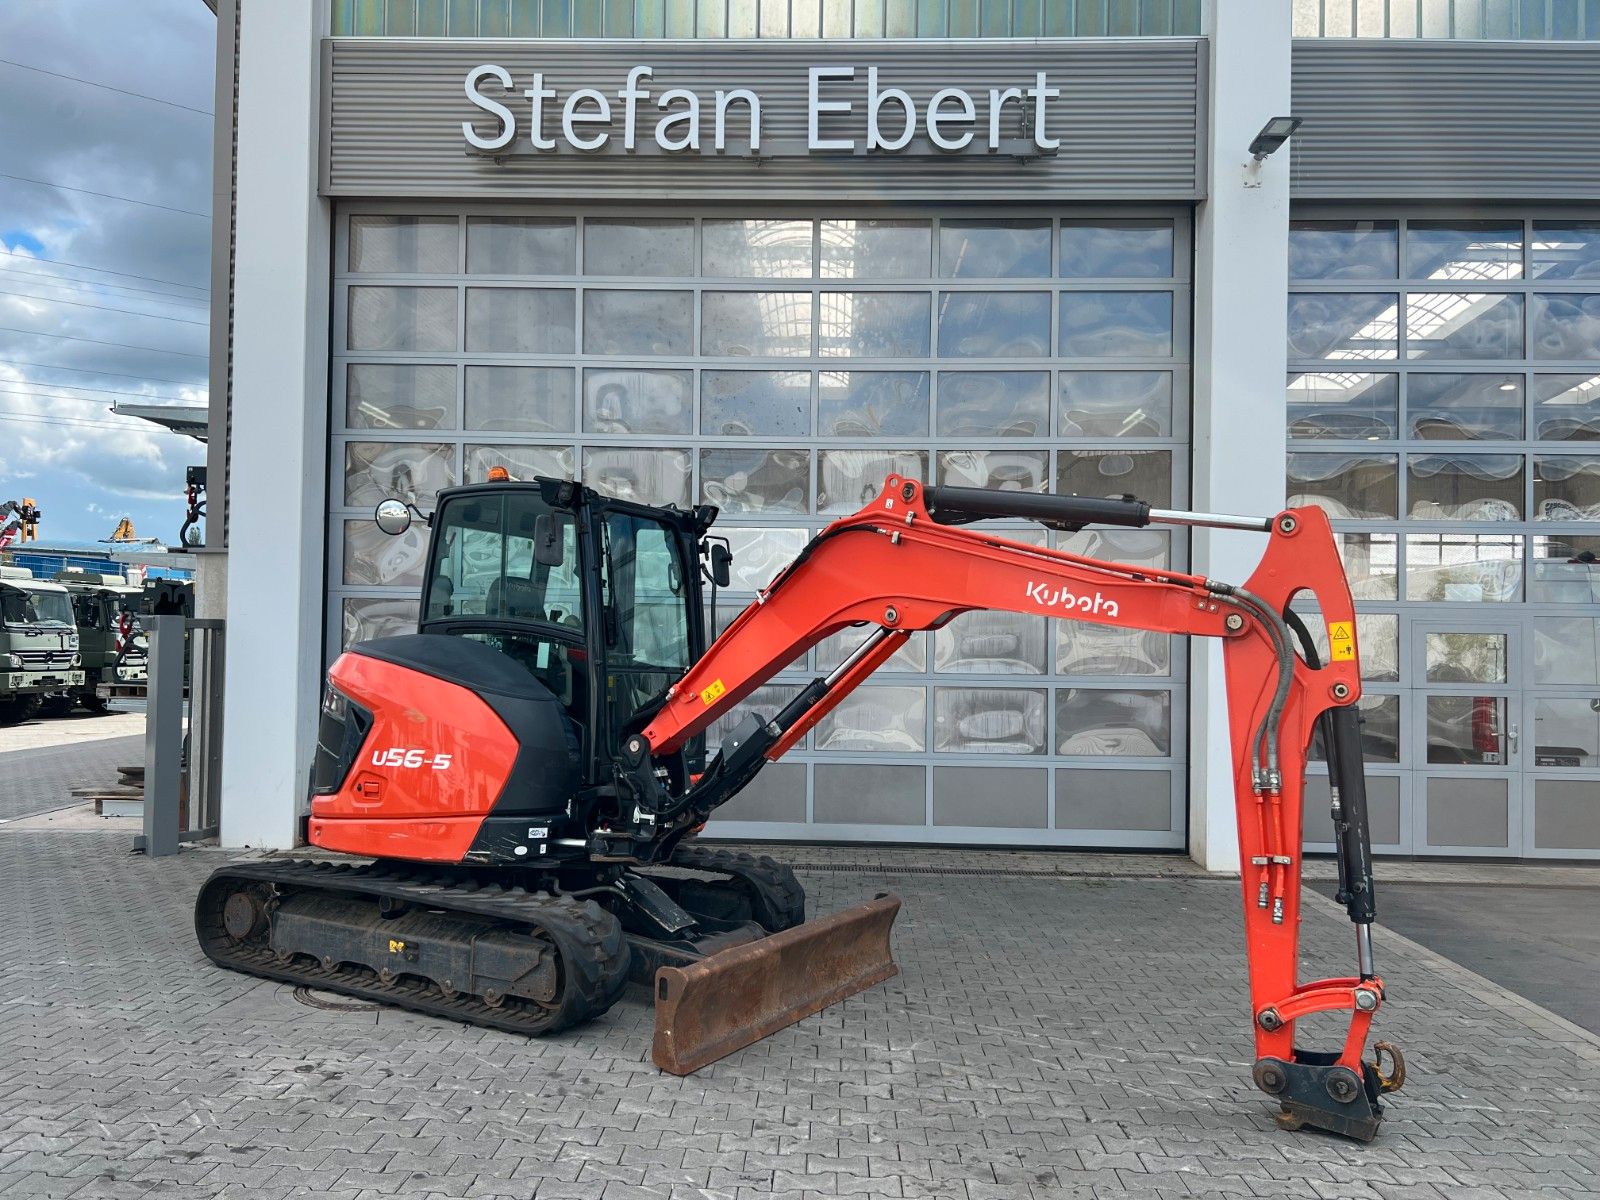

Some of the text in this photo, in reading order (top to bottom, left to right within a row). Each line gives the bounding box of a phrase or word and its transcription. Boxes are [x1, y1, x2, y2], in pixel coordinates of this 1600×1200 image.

[461, 64, 1061, 152] Stefan Ebert
[1025, 581, 1119, 617] Kubota
